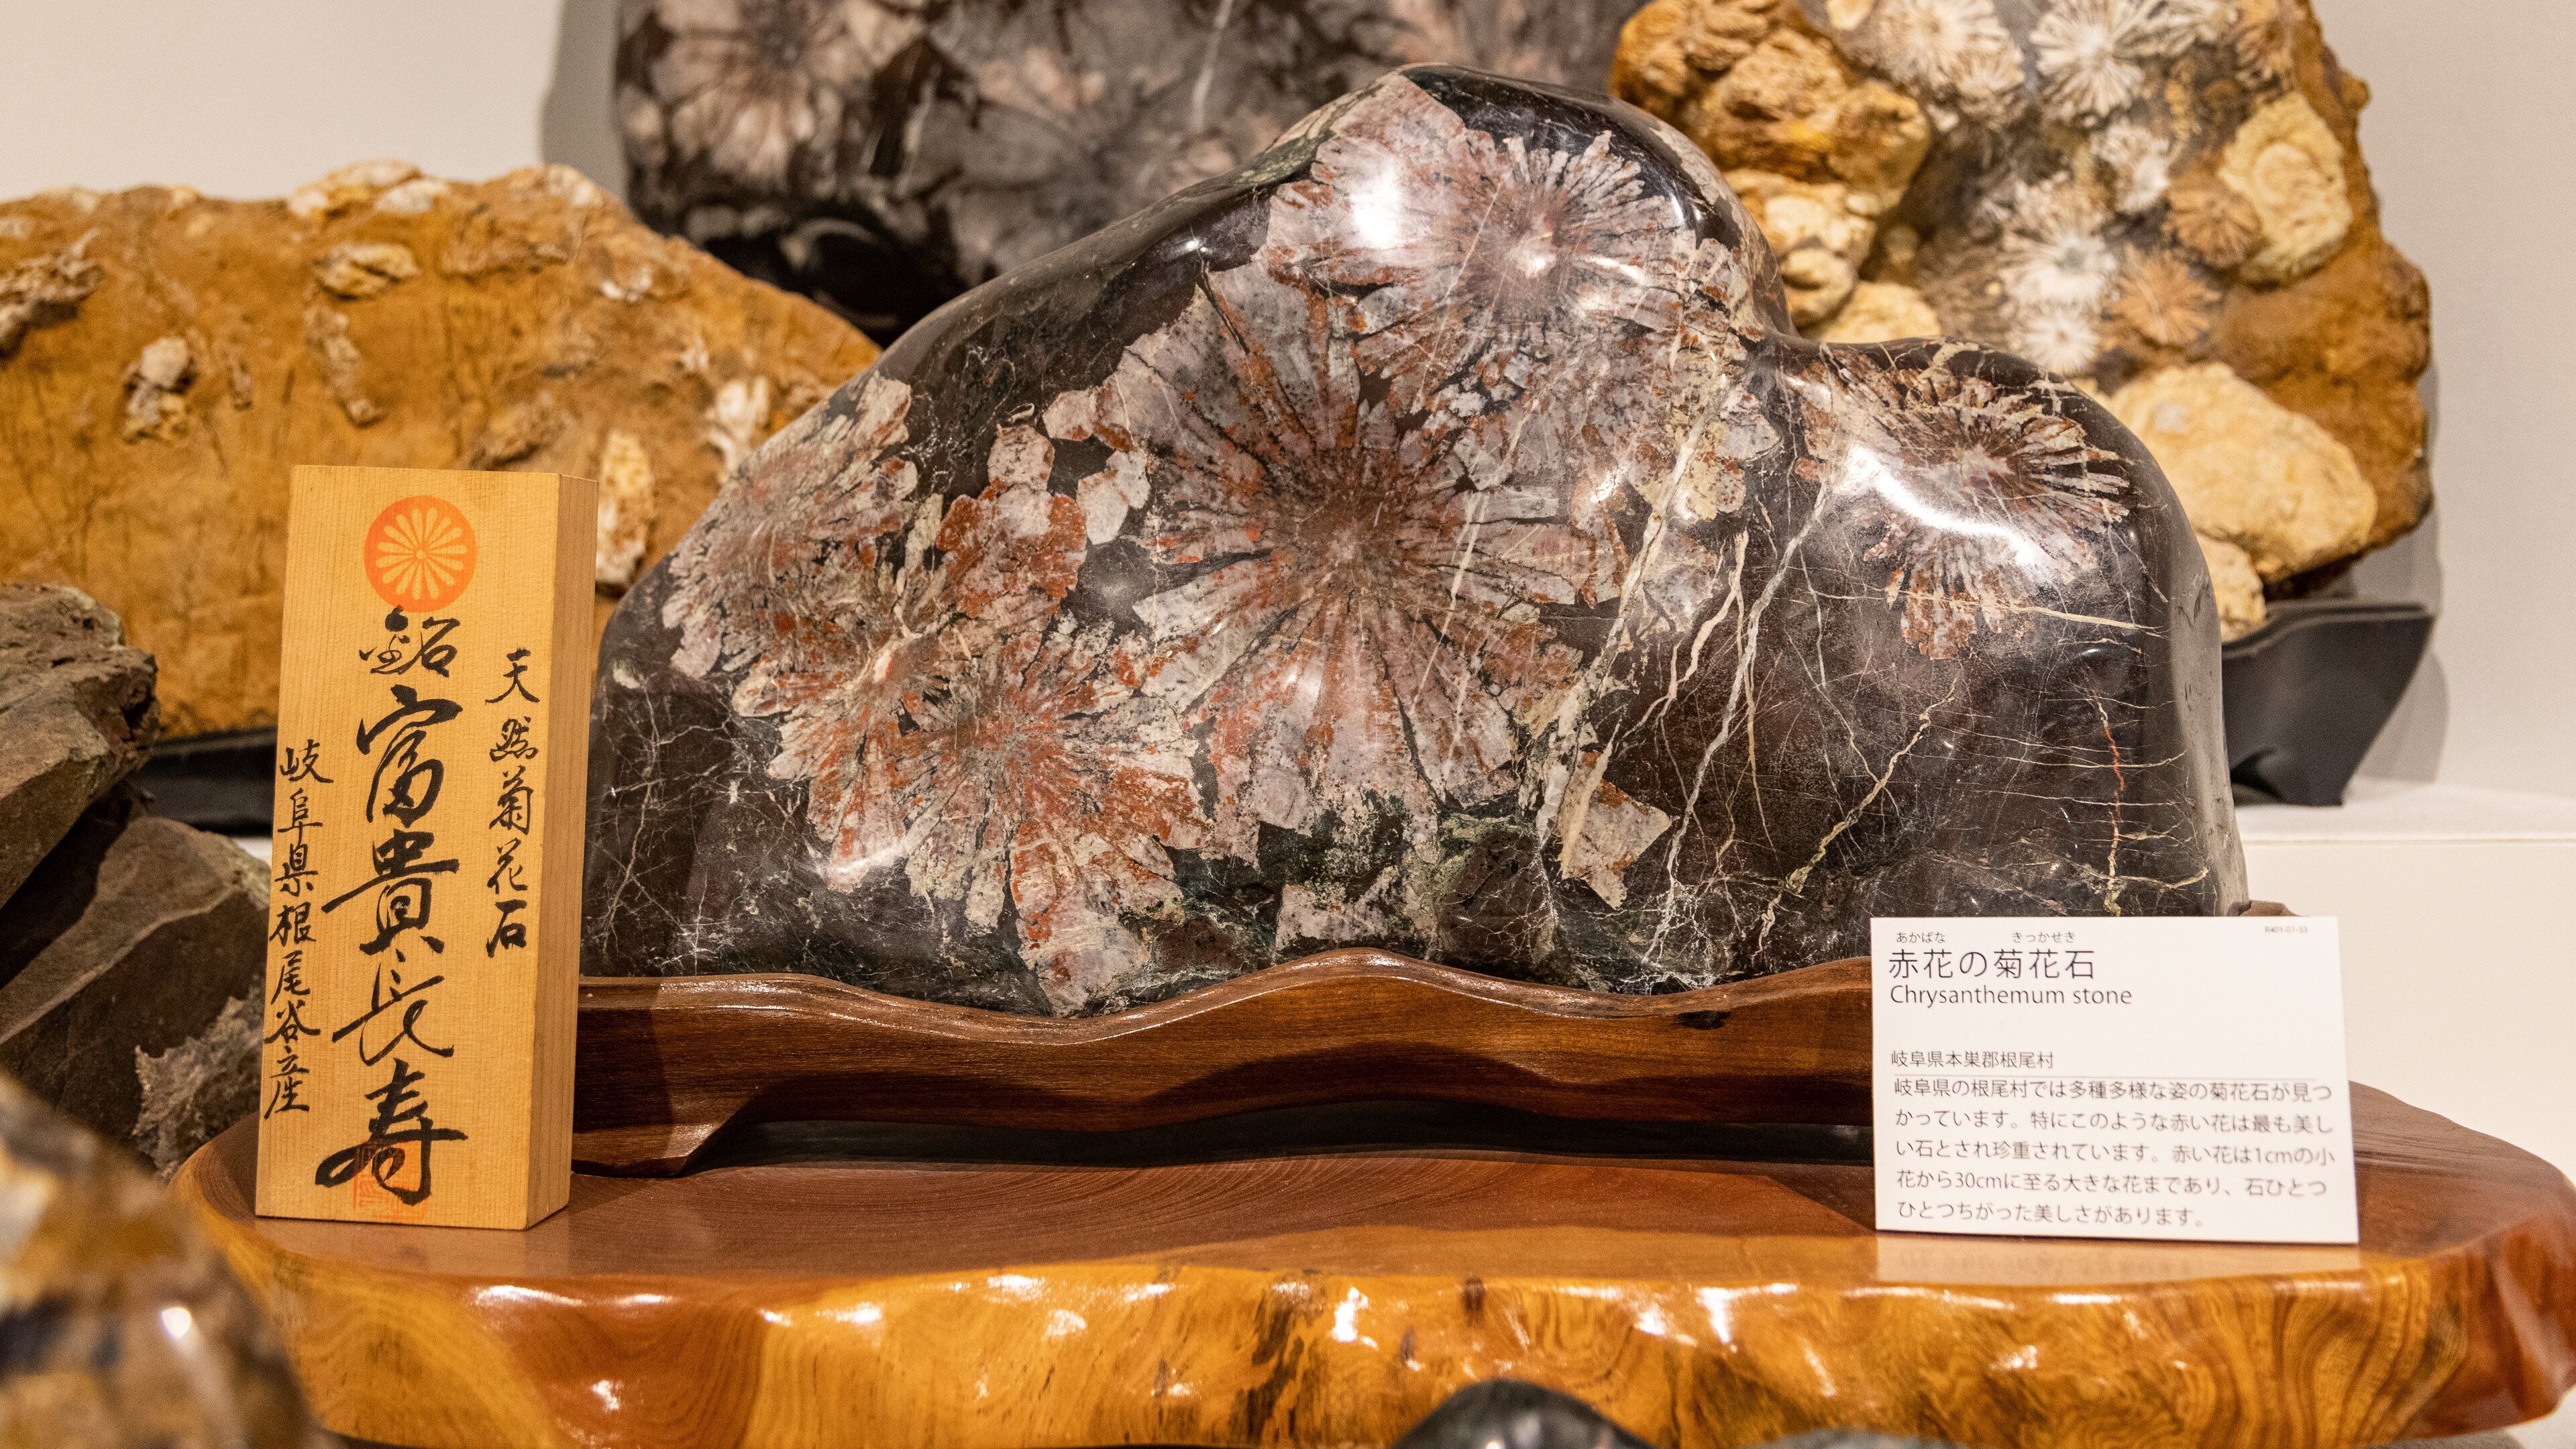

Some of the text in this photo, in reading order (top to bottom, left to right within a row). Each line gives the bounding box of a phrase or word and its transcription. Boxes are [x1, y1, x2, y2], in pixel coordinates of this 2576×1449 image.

[484, 647, 541, 958] 天然菊花石
[1896, 932, 2074, 943] あかばな きっかせき
[1888, 948, 2095, 979] 赤花の菊花石
[1890, 984, 2133, 1009] Chrysanthemum stone
[1890, 1051, 2053, 1069] 岐阜県本巣郡根尾村
[1894, 1079, 2332, 1102] 岐阜県の根尾村では多種多様な姿の菊花石が見つ
[1898, 1201, 2202, 1227] ひとつちがった美しさがあります。
